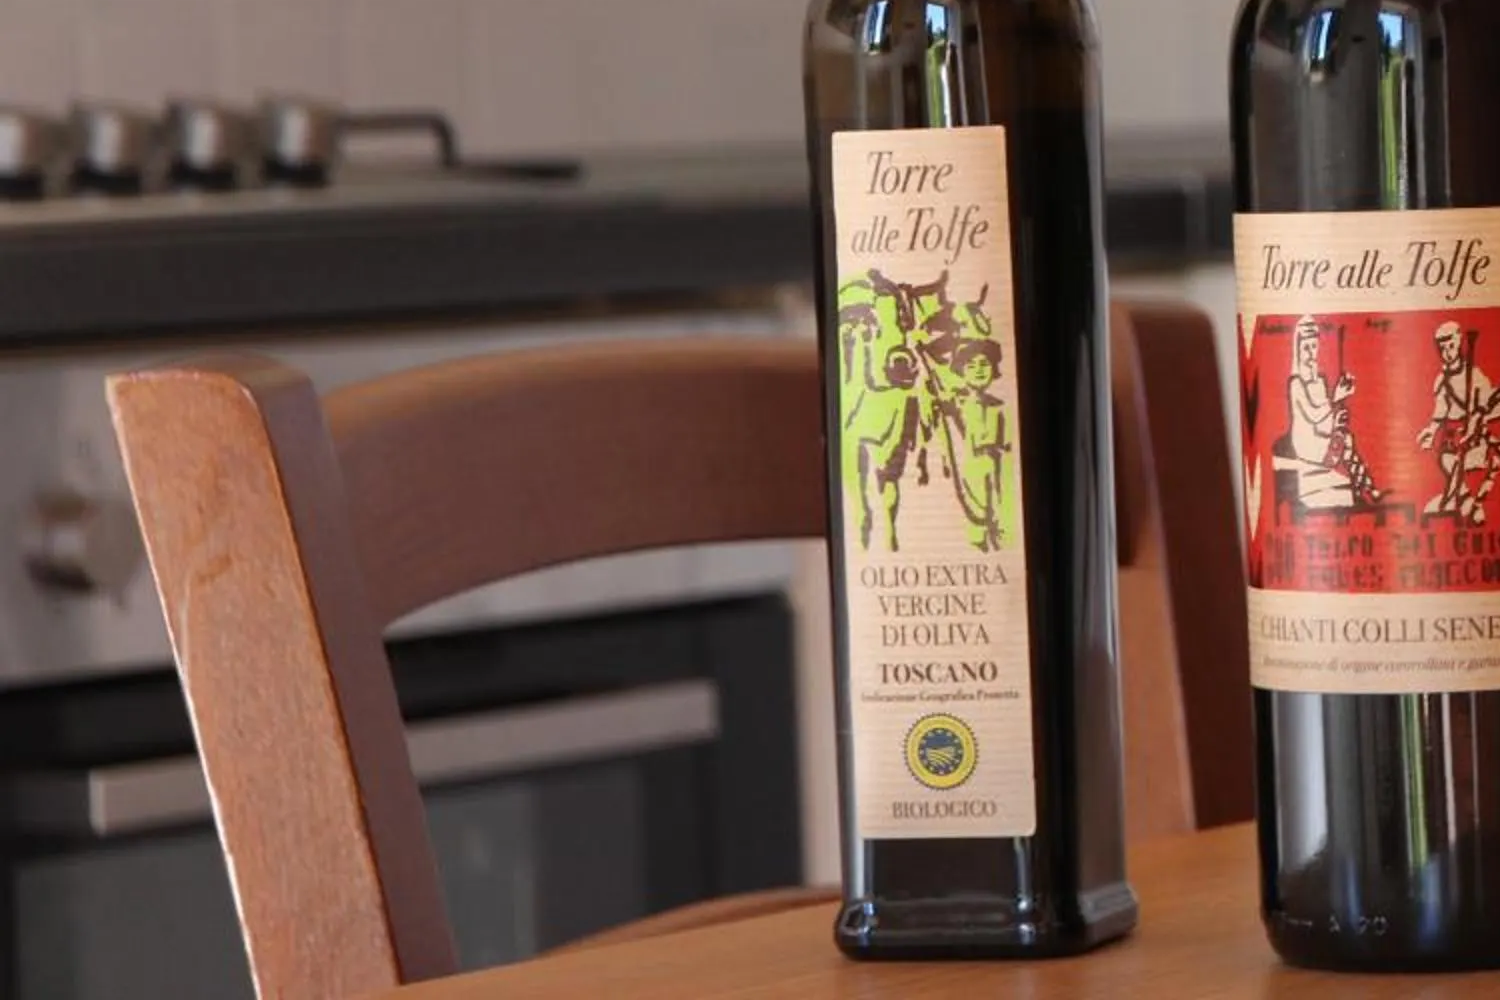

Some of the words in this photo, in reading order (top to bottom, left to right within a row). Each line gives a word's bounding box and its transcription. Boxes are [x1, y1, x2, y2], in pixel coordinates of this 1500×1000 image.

[866, 151, 954, 195] Torre
[850, 215, 900, 254] alle
[906, 203, 990, 265] Tolfe
[1261, 244, 1331, 290] Torre
[1336, 249, 1393, 289] alle
[1403, 238, 1492, 301] Tolfe
[860, 565, 920, 588] OLIO
[925, 563, 1008, 588] EXTRA
[877, 593, 988, 618] VERGINE
[881, 624, 907, 648] DI
[913, 622, 991, 647] OLIVA
[1260, 615, 1336, 643] CHIANTI
[1342, 618, 1426, 643] COLLI
[878, 660, 999, 686] TOSCANO
[891, 799, 998, 819] BIOLOGICO
